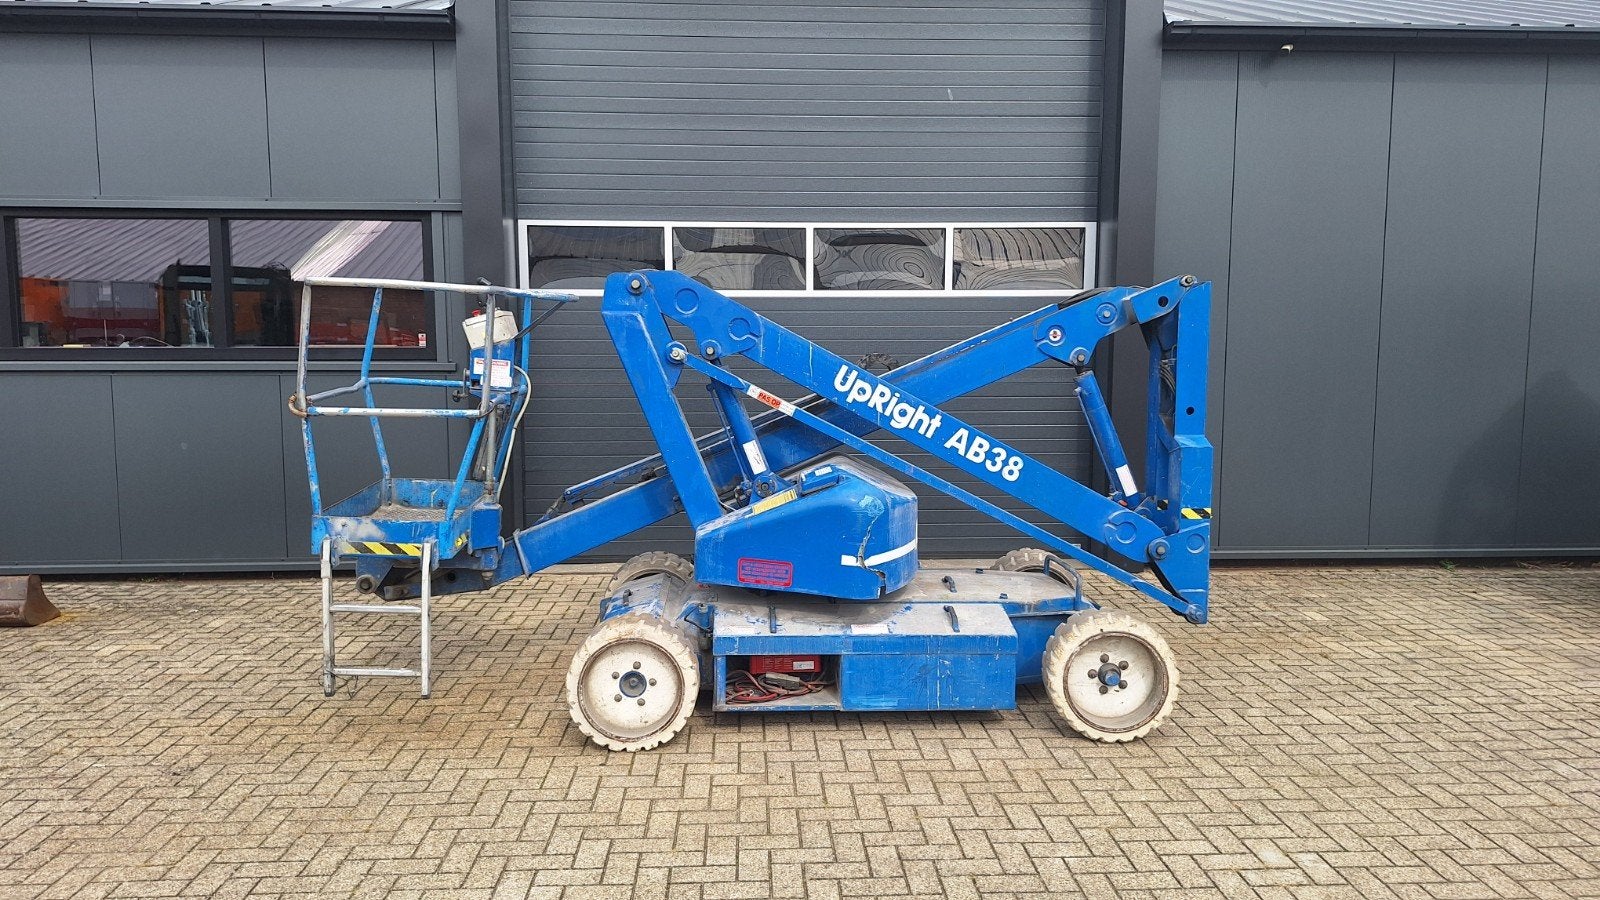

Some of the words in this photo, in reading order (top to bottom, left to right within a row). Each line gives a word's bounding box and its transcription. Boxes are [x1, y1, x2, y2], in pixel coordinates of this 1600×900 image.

[758, 392, 771, 403] PAS
[771, 399, 781, 407] OP
[833, 364, 942, 439] UpRight
[943, 427, 1024, 482] AB38
